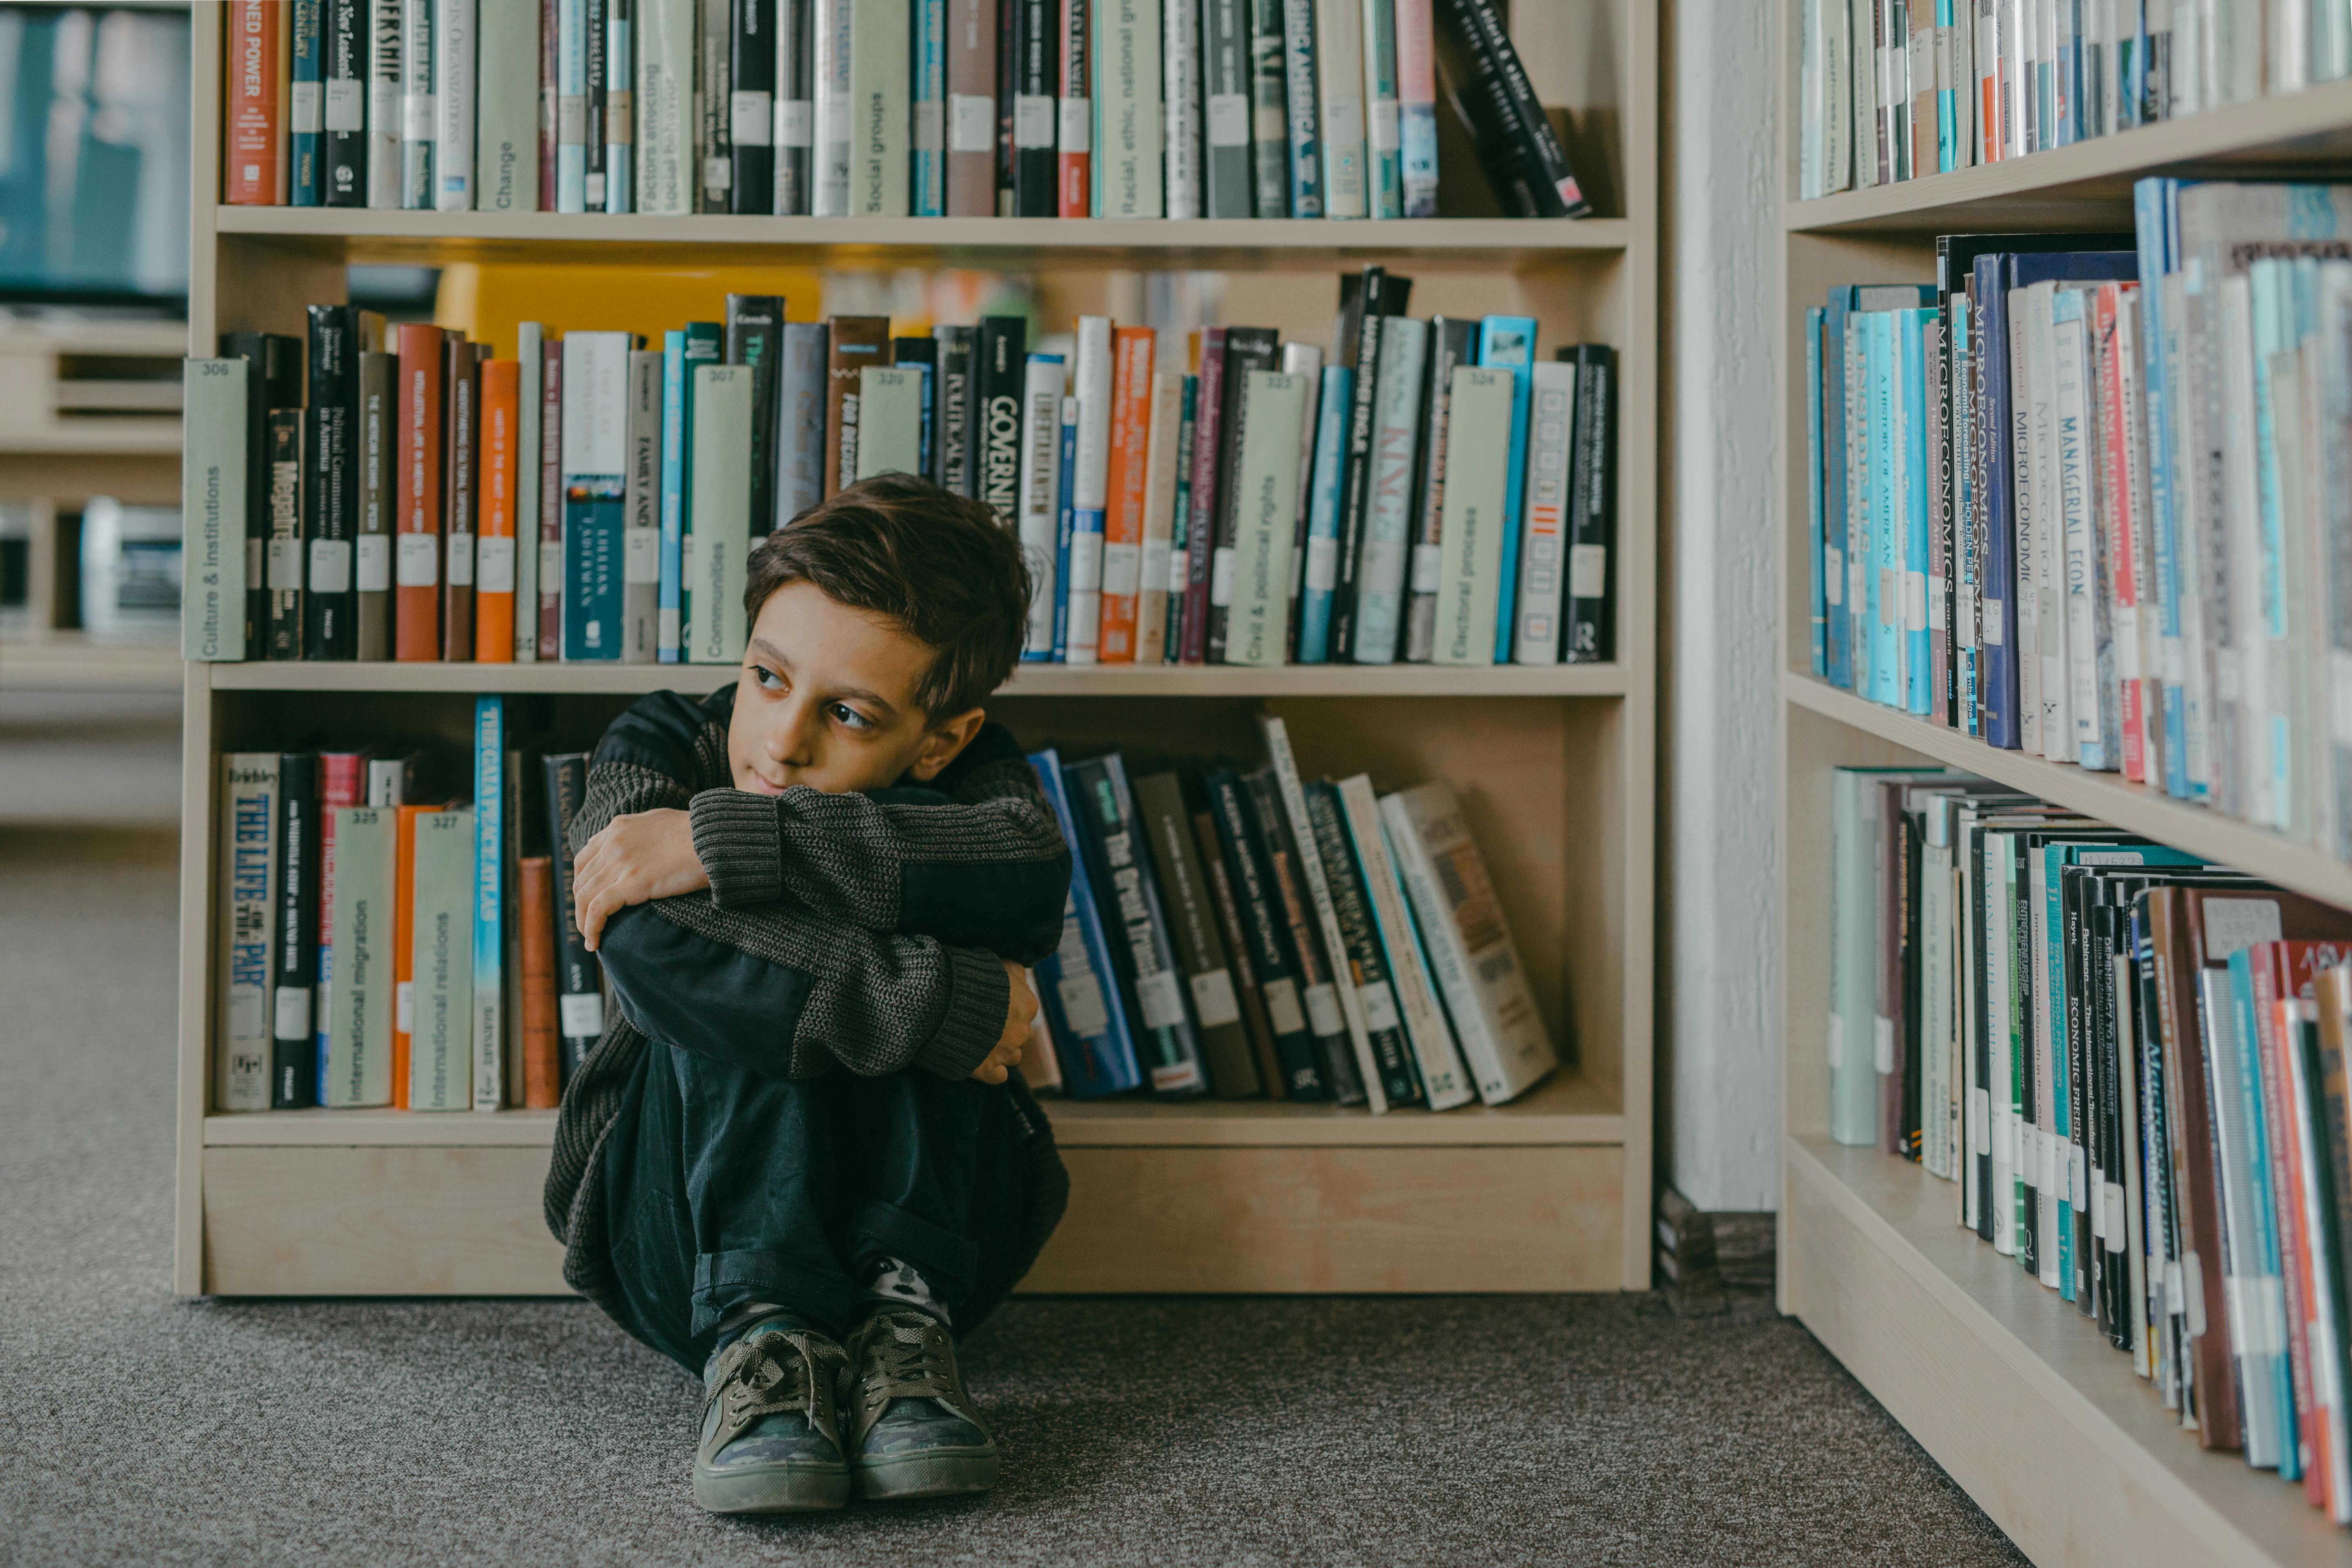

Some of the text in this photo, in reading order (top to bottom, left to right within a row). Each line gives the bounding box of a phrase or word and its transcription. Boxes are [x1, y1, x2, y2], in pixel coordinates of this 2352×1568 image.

[296, 1, 308, 58] CENTURY
[245, 36, 260, 96] POWER
[1118, 28, 1137, 98] national
[1295, 52, 1314, 147] AMERICA
[1827, 37, 1836, 189] Other resources
[643, 64, 659, 212] Factors affecting
[867, 92, 886, 213] Social groups
[496, 142, 516, 209] Change
[664, 159, 678, 212] social
[1120, 156, 1137, 214] Racial,
[203, 363, 229, 376] 306
[709, 370, 735, 382] 307
[1131, 337, 1151, 398] WOMEN
[332, 407, 345, 454] Political
[369, 394, 379, 410] THE
[842, 393, 858, 423] FOR
[946, 374, 964, 460] POLITICAL
[1961, 360, 1971, 484] Economic forecasting:
[1975, 305, 1989, 555] MICROECONOMICS
[636, 437, 651, 528] FAMILY AND
[1030, 393, 1055, 516] LIBERTARIANISM
[1880, 374, 1891, 564] A HISTORY OF AMERICAN
[1939, 325, 1953, 593] MICROECONOMICS
[2014, 321, 2031, 582] Mansfield MICROECONOMIC
[2061, 416, 2082, 536] MANAGERIAL
[270, 461, 298, 539] Megatre
[1260, 476, 1277, 526] rights
[1933, 507, 1940, 520] of
[1964, 501, 1973, 553] HOLDEN,
[1969, 390, 1982, 651] MICROECONOMICS
[203, 466, 220, 657] Culture & institutions
[596, 529, 608, 595] LILLIAN
[1253, 530, 1272, 600] political
[1451, 507, 1478, 659] Electoral process
[708, 541, 725, 658] Communities
[1246, 622, 1263, 660] Civil
[1966, 661, 1974, 719] Cambridge
[236, 793, 269, 842] THE
[352, 812, 378, 824] 325
[432, 817, 458, 829] 327
[479, 706, 499, 922] THE GAIA PEACE ATLAS
[234, 847, 268, 902] LIFE
[1984, 851, 1994, 940] BEYOND
[2020, 899, 2029, 996] ENTREPRENEURSHIP
[2049, 942, 2054, 956] OF
[2097, 969, 2104, 979] by
[349, 900, 371, 1102] International migration
[432, 912, 448, 1107] International relations
[2019, 1007, 2023, 1019] OF
[2254, 971, 2268, 998] THE
[2071, 996, 2080, 1081] ECONOMIC
[2104, 937, 2114, 1115] DEPENDENCY TO ENTERPRISE
[2256, 1004, 2271, 1046] QUEST
[2037, 1065, 2041, 1076] in
[2085, 1029, 2094, 1099] International
[2261, 1049, 2274, 1075] FOR
[2072, 1086, 2082, 1147] FREEDO
[2089, 1148, 2096, 1160] of
